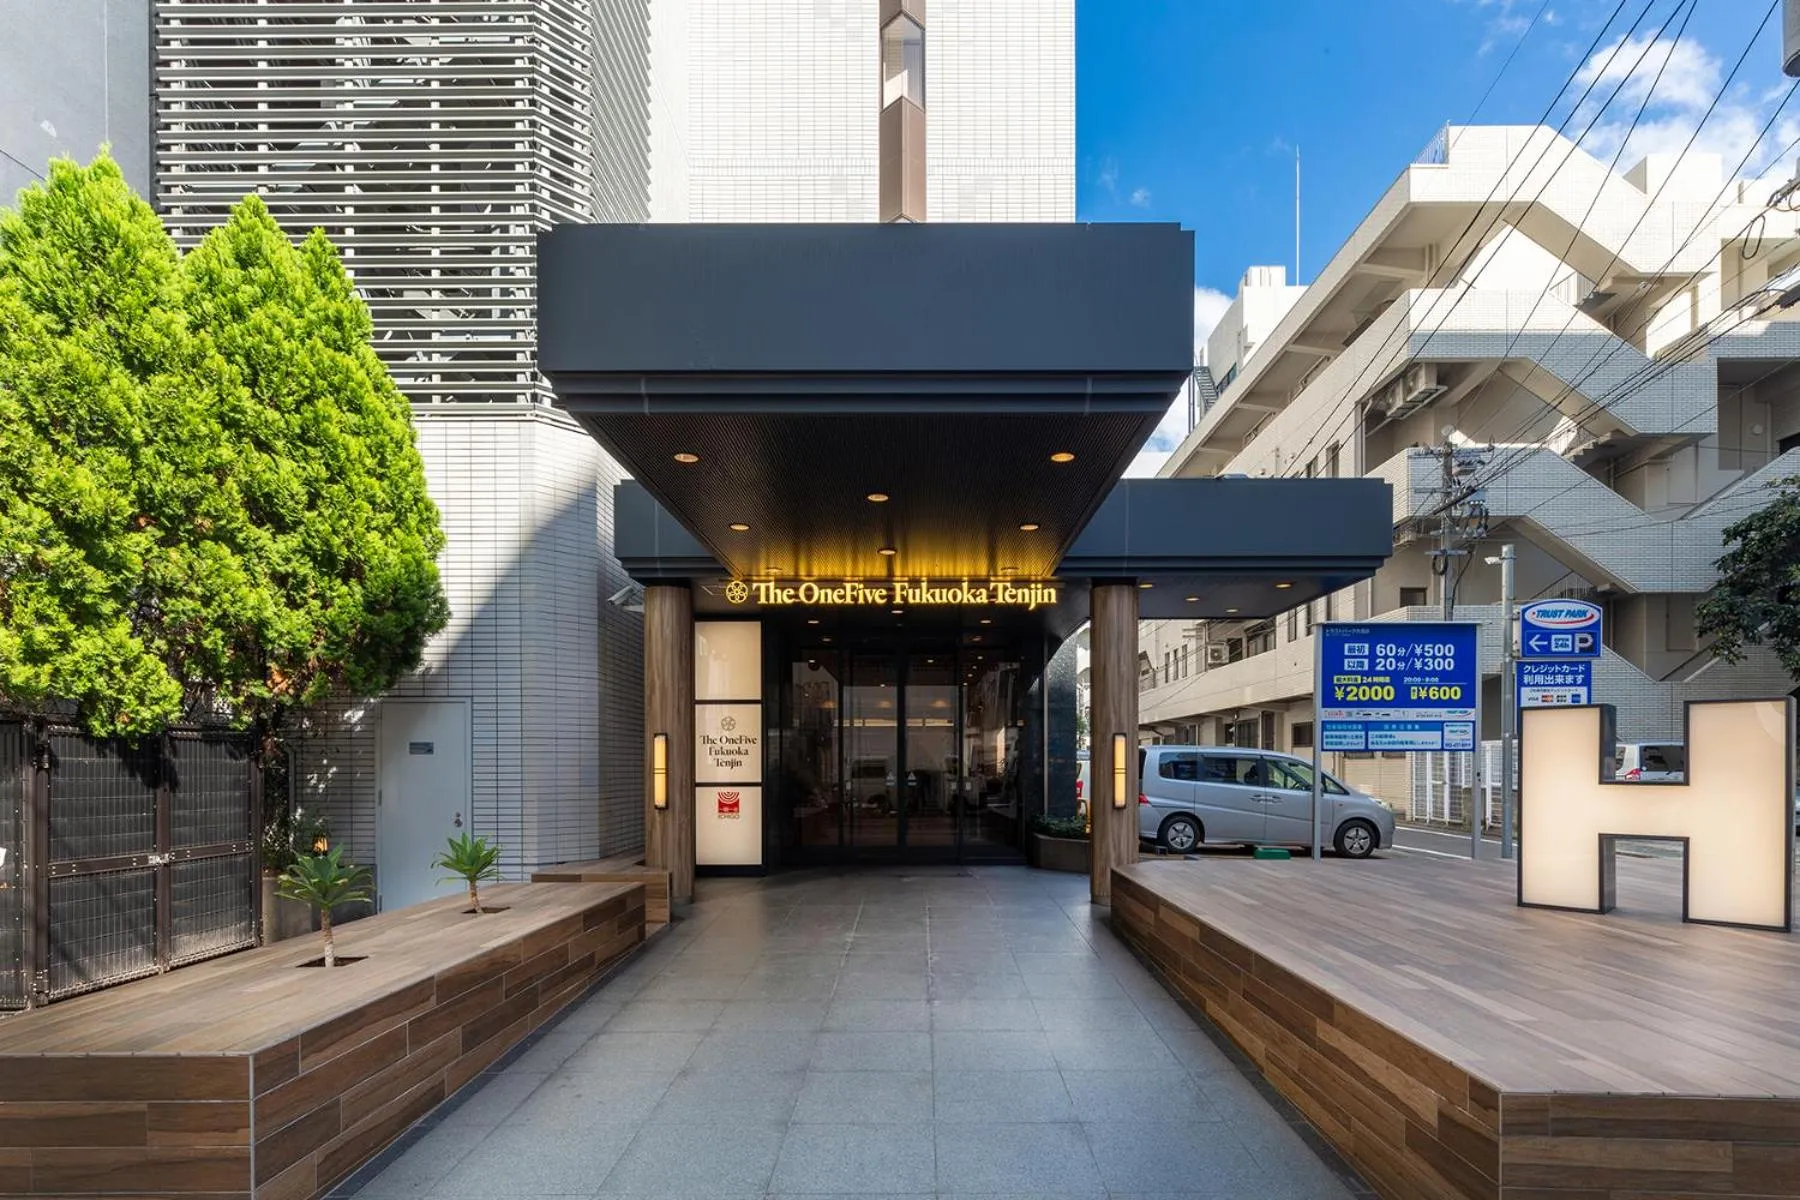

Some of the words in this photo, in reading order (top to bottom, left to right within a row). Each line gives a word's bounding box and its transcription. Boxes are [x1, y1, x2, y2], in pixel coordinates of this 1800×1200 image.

[752, 580, 795, 605] The
[799, 581, 887, 605] OneFive
[892, 579, 987, 605] Fukuoka
[989, 580, 1057, 611] Tenjin
[1536, 609, 1564, 619] TRUST
[1565, 609, 1588, 618] PARK
[1574, 633, 1593, 654] P
[1523, 664, 1585, 673] クレジットカード
[1523, 674, 1585, 685] 利用出来ます
[1335, 685, 1395, 701] ¥2000
[700, 735, 718, 745] The
[720, 735, 758, 745] OneFive
[708, 747, 749, 756] Fukuoka
[713, 758, 743, 770] Tenjin
[1518, 696, 1792, 933] H
